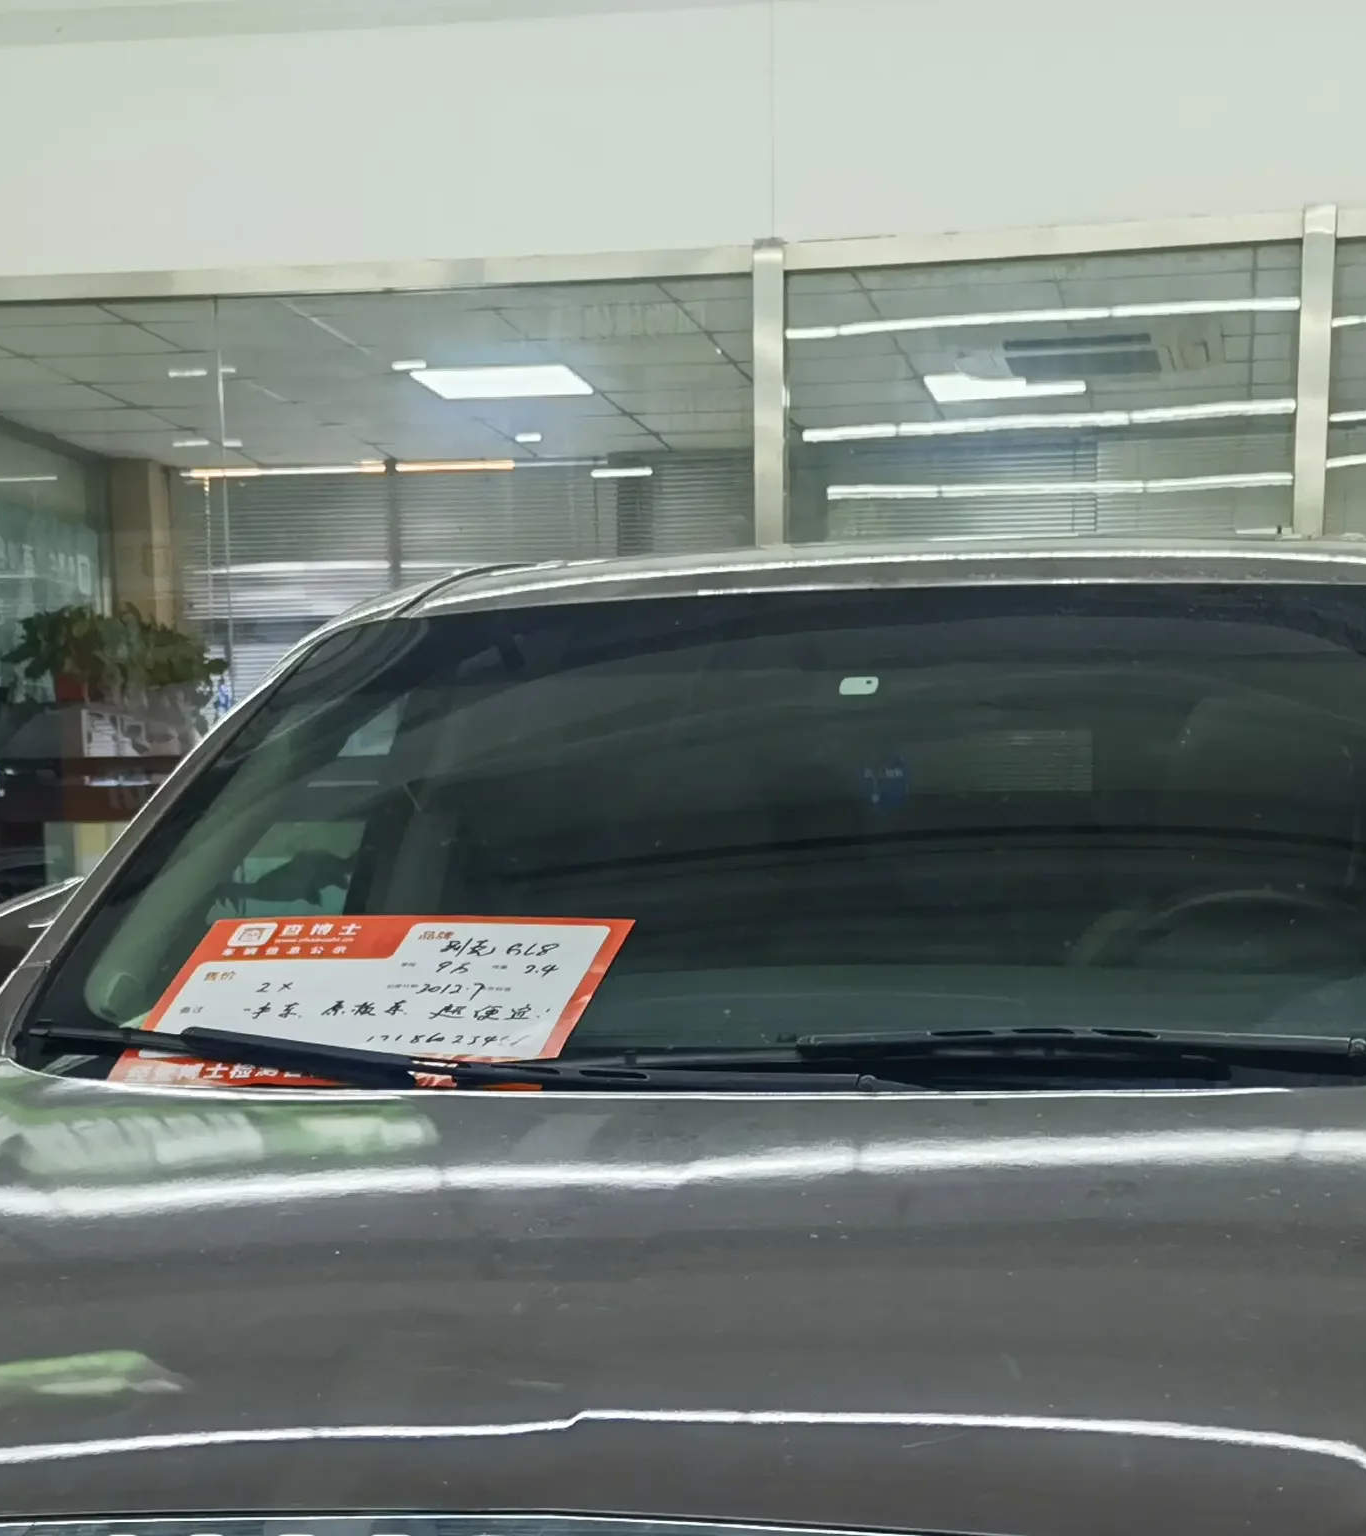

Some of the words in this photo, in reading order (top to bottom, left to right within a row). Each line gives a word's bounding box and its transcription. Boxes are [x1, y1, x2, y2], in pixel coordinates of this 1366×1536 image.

[281, 923, 362, 937] 查博士
[418, 931, 455, 941] 品牌
[203, 970, 236, 982] 售价
